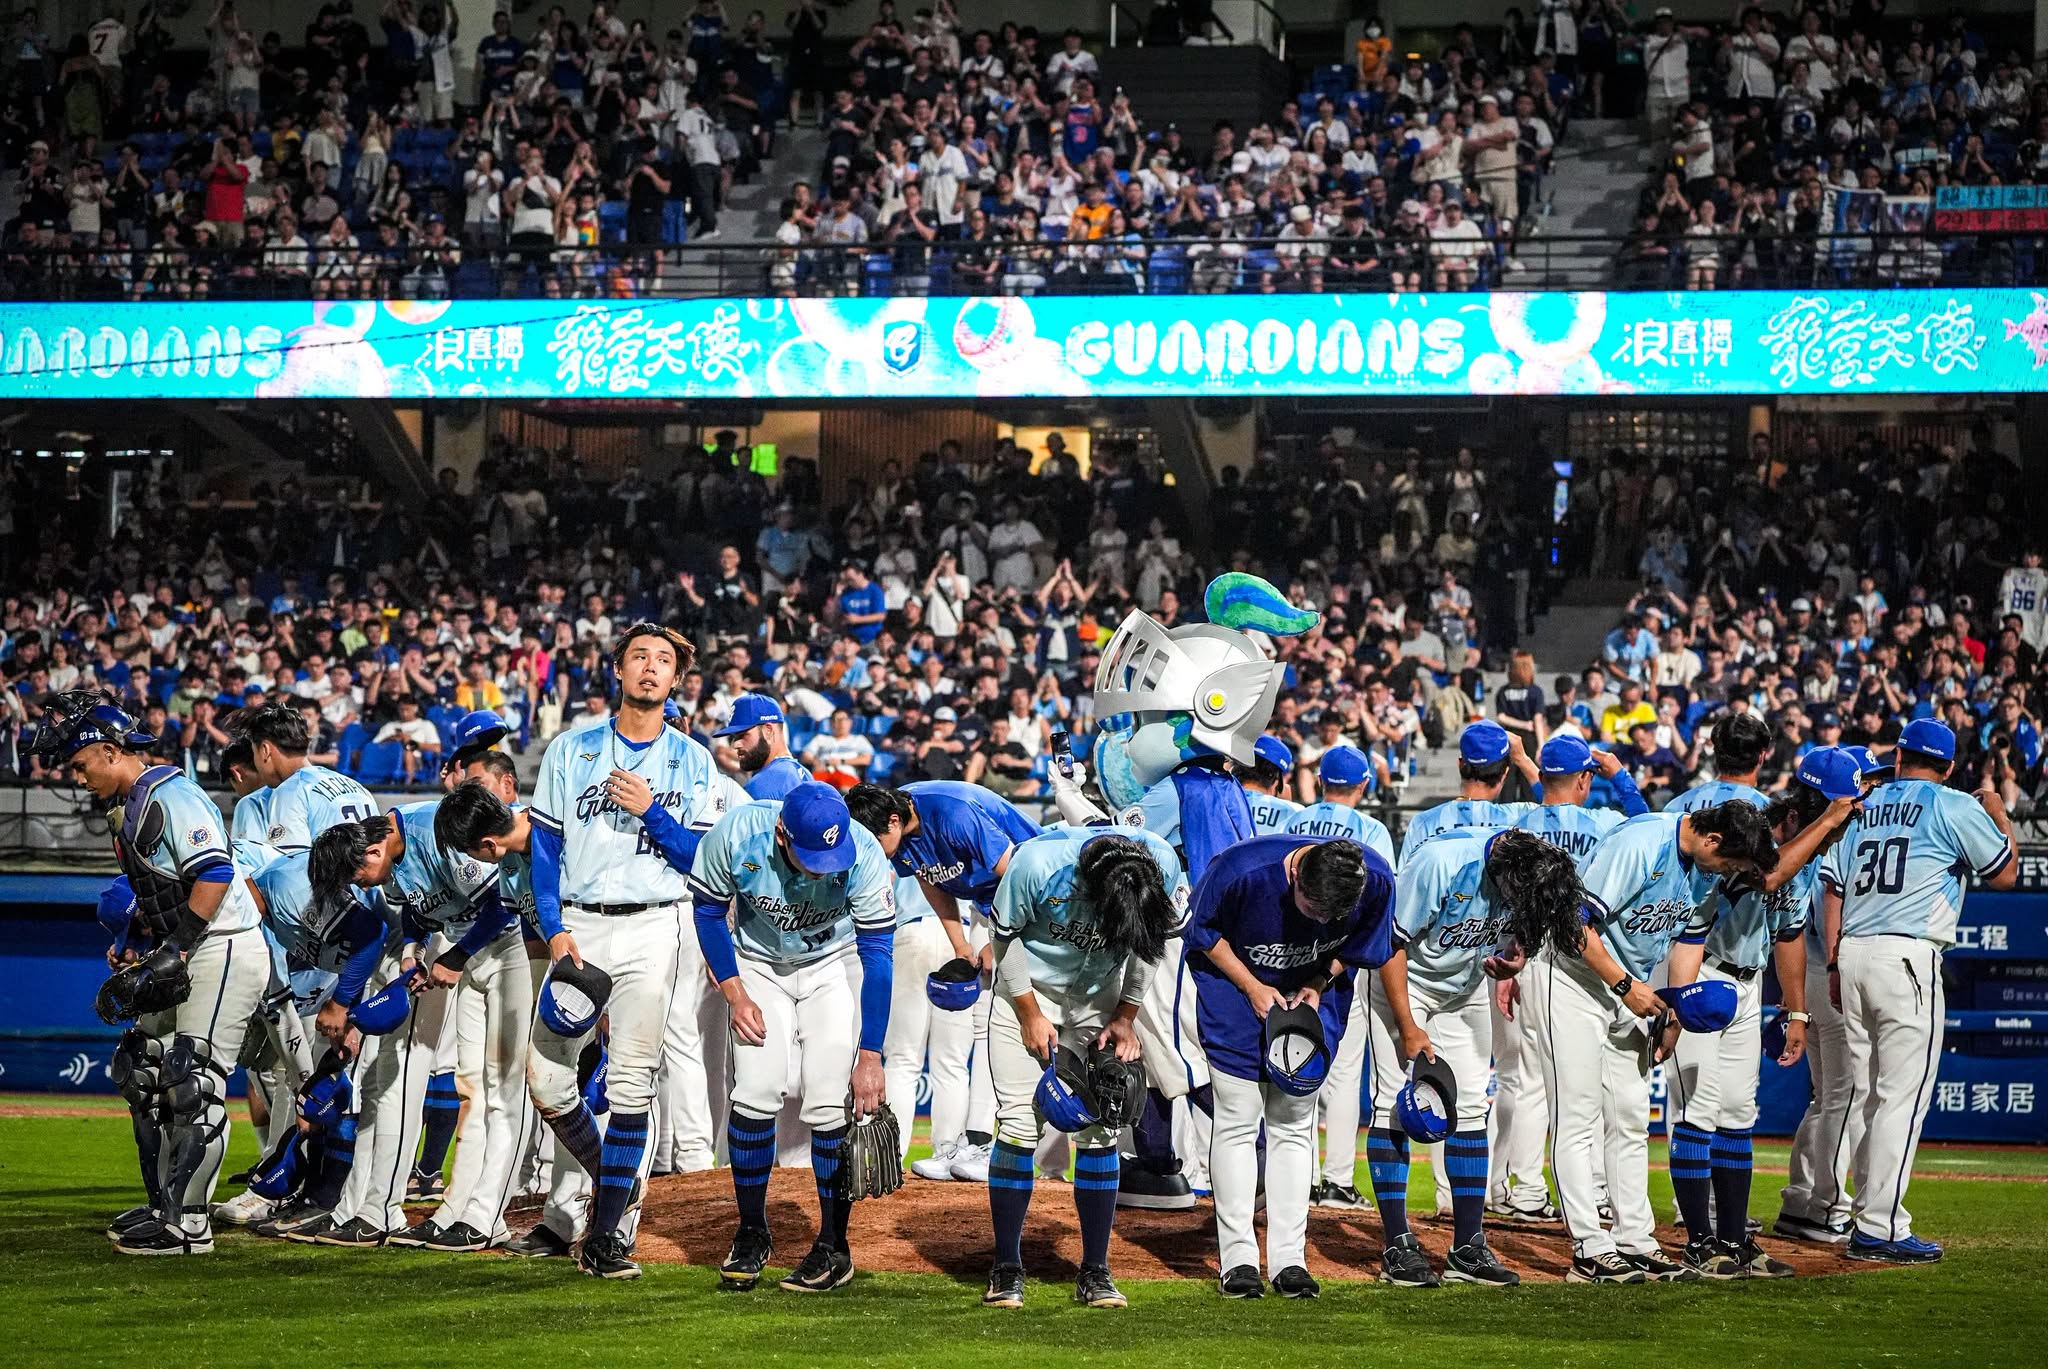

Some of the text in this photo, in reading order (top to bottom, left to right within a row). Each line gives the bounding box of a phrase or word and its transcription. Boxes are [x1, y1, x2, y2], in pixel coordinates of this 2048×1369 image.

[0, 325, 283, 378] ARDIANS
[1066, 318, 1465, 377] GUARDIANS
[464, 724, 482, 737] momo
[1854, 836, 1909, 897] 30
[755, 895, 801, 916] Fubon
[1955, 925, 2009, 951] 工程
[1267, 943, 1312, 956] Fubon
[367, 994, 390, 1010] momo
[594, 1062, 609, 1084] momo
[317, 1098, 335, 1116] momo
[1936, 1081, 2035, 1114] 稻家居
[265, 1167, 285, 1186] momo
